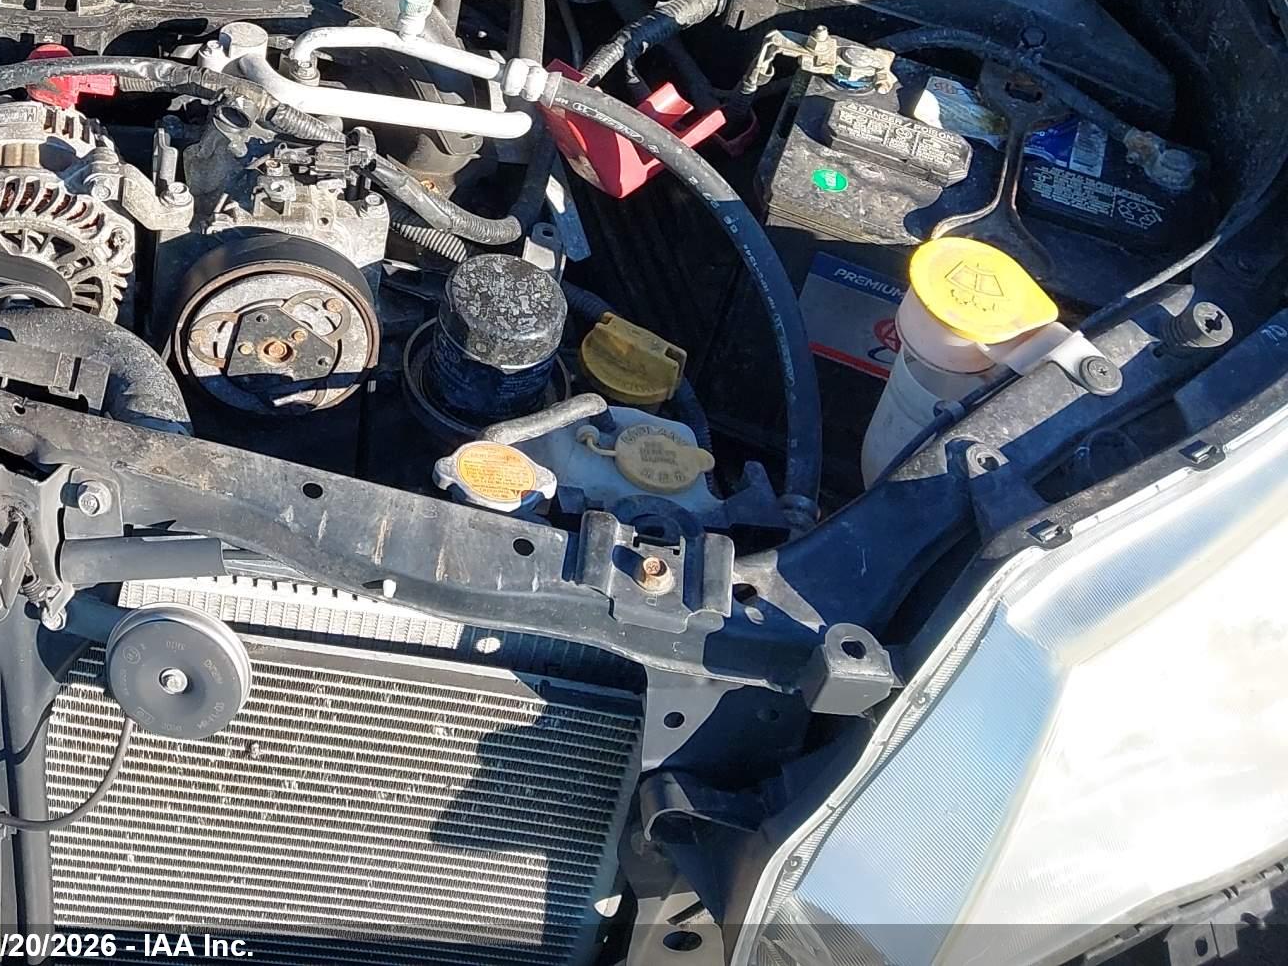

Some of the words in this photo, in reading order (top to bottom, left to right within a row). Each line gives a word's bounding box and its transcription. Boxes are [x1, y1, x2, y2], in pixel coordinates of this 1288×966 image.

[857, 106, 903, 126] DANGER
[914, 123, 955, 142] POISON
[833, 268, 905, 299] PREMIUM
